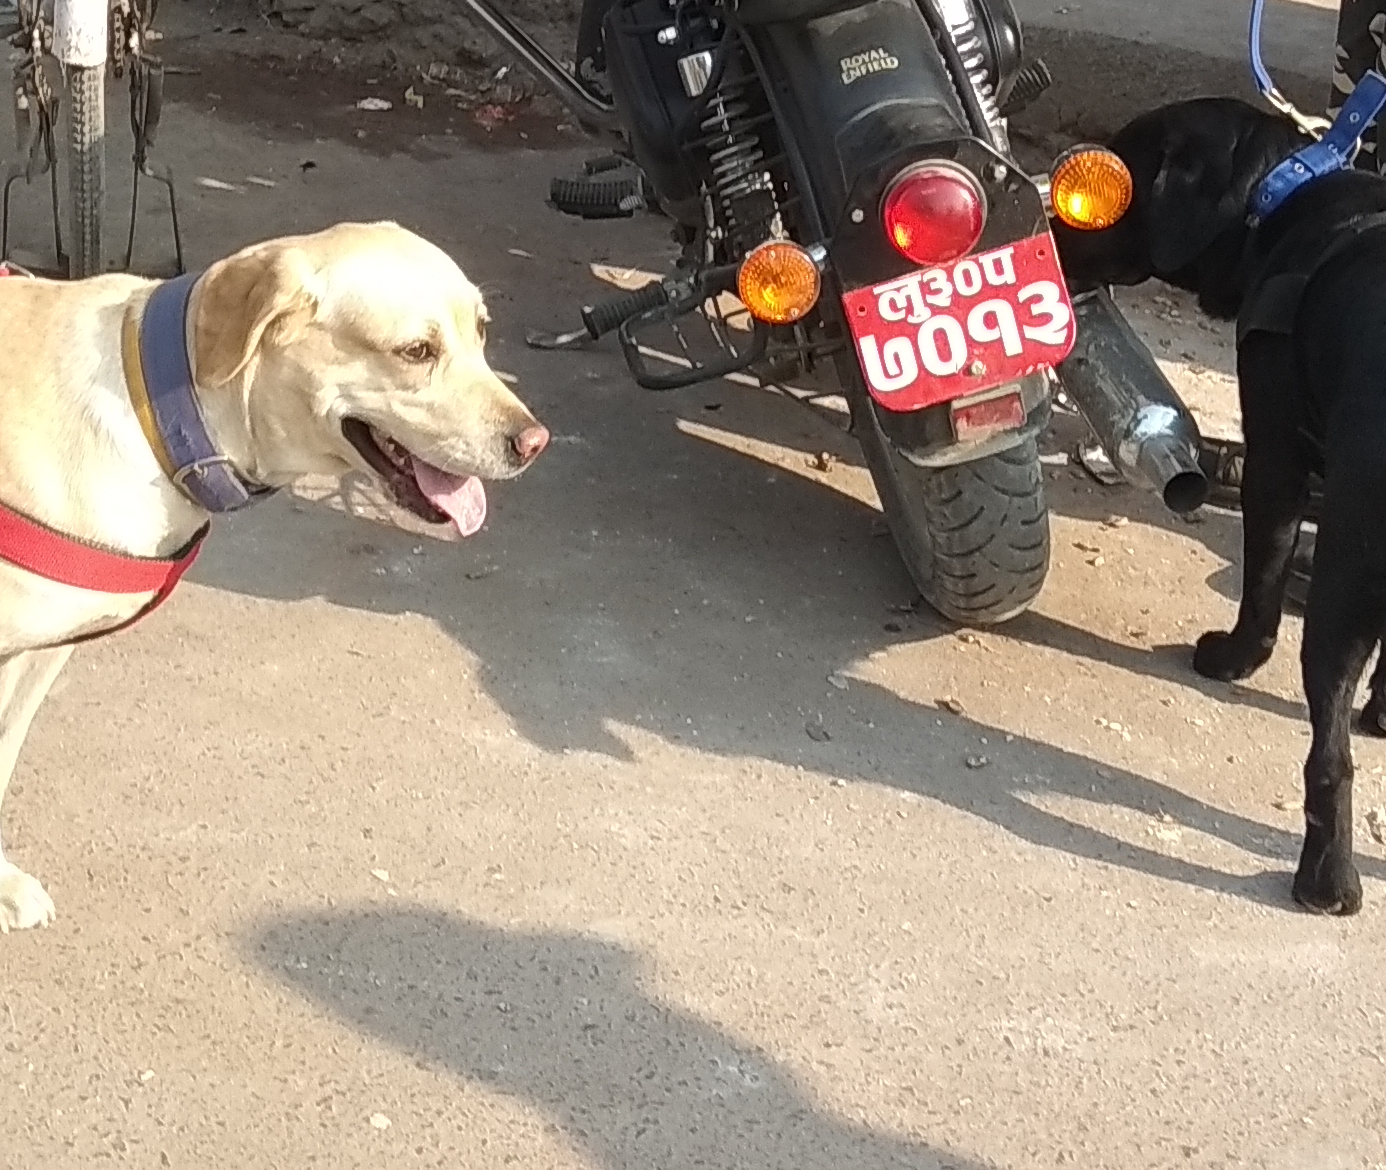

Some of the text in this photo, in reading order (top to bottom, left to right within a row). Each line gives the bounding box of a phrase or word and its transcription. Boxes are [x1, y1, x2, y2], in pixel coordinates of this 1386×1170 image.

[840, 47, 889, 71] ROYAL
[841, 56, 900, 85] ENFIELD
[859, 280, 1071, 392] ७०१३
